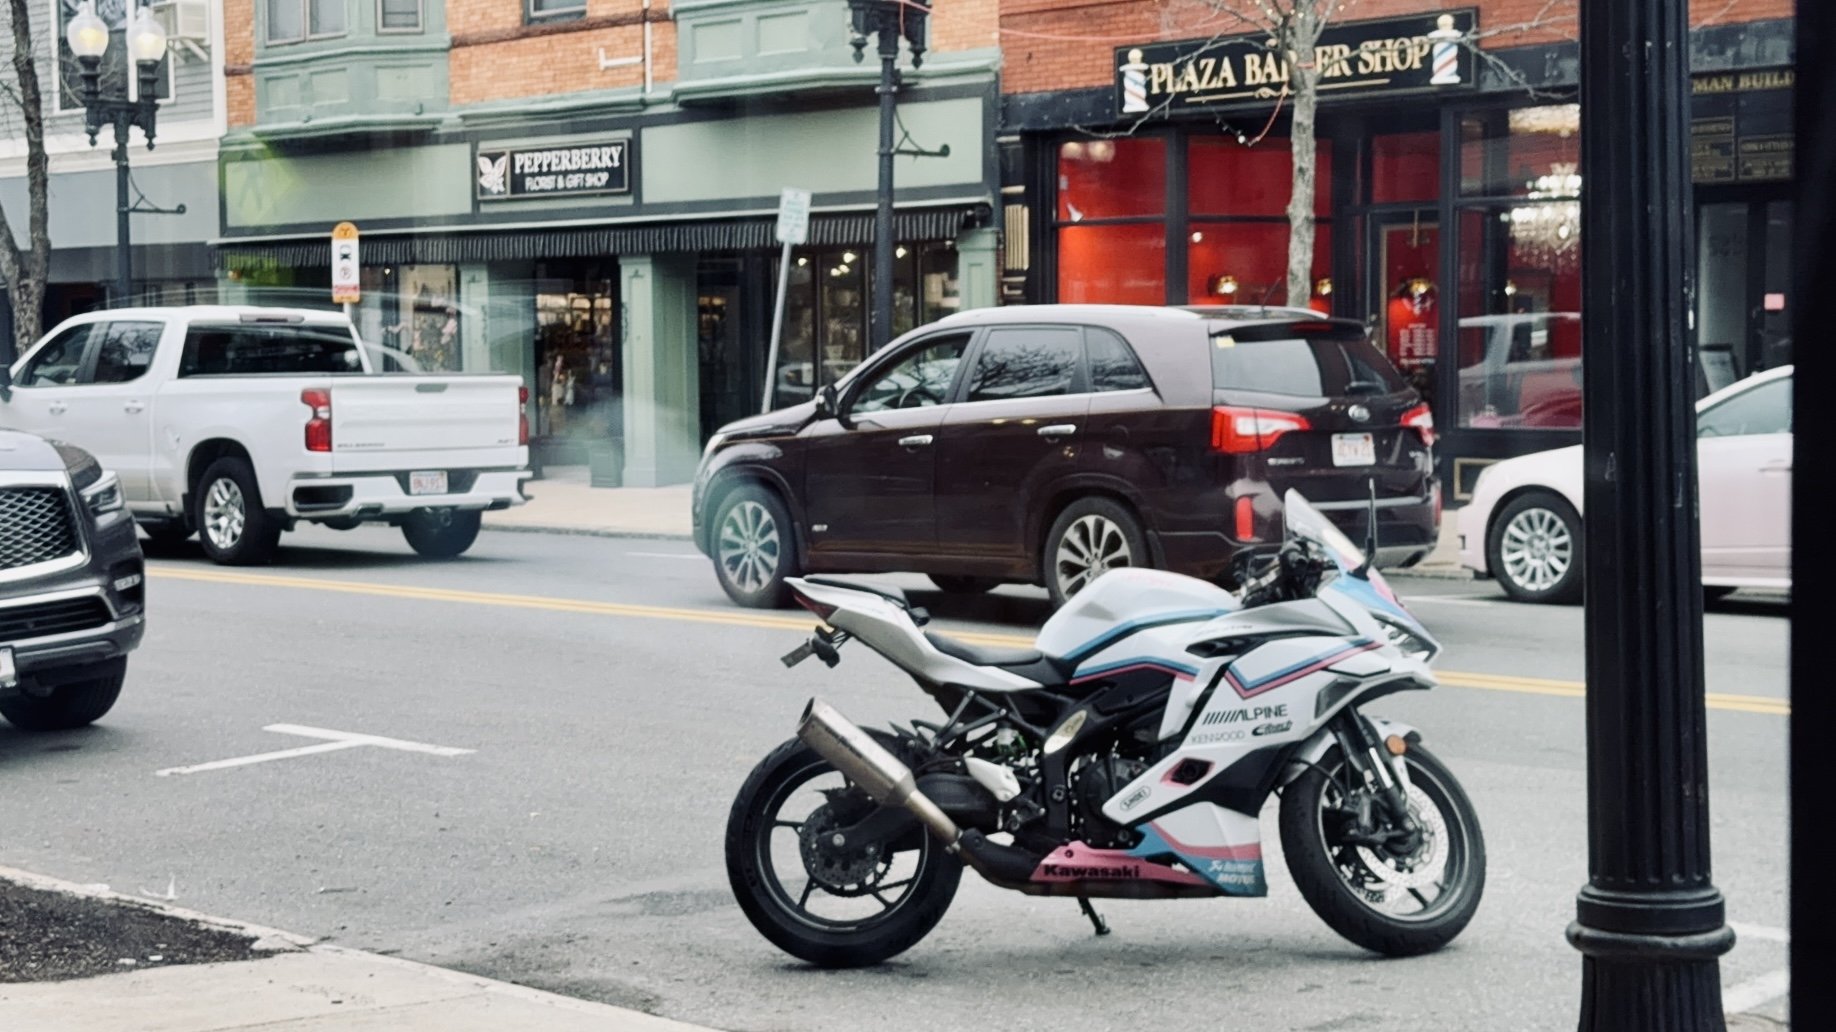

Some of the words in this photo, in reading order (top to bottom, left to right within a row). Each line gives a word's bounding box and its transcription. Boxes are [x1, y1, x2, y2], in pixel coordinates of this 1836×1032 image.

[1150, 56, 1237, 94] PLAZA
[1245, 44, 1353, 86] BAER
[1357, 36, 1430, 75] SHOP
[515, 146, 622, 174] PEPPERBERRY
[585, 171, 609, 188] SHOP
[1236, 704, 1289, 722] ALPINE
[1191, 730, 1246, 743] KENWOOD
[1043, 863, 1141, 878] Kawasaki
